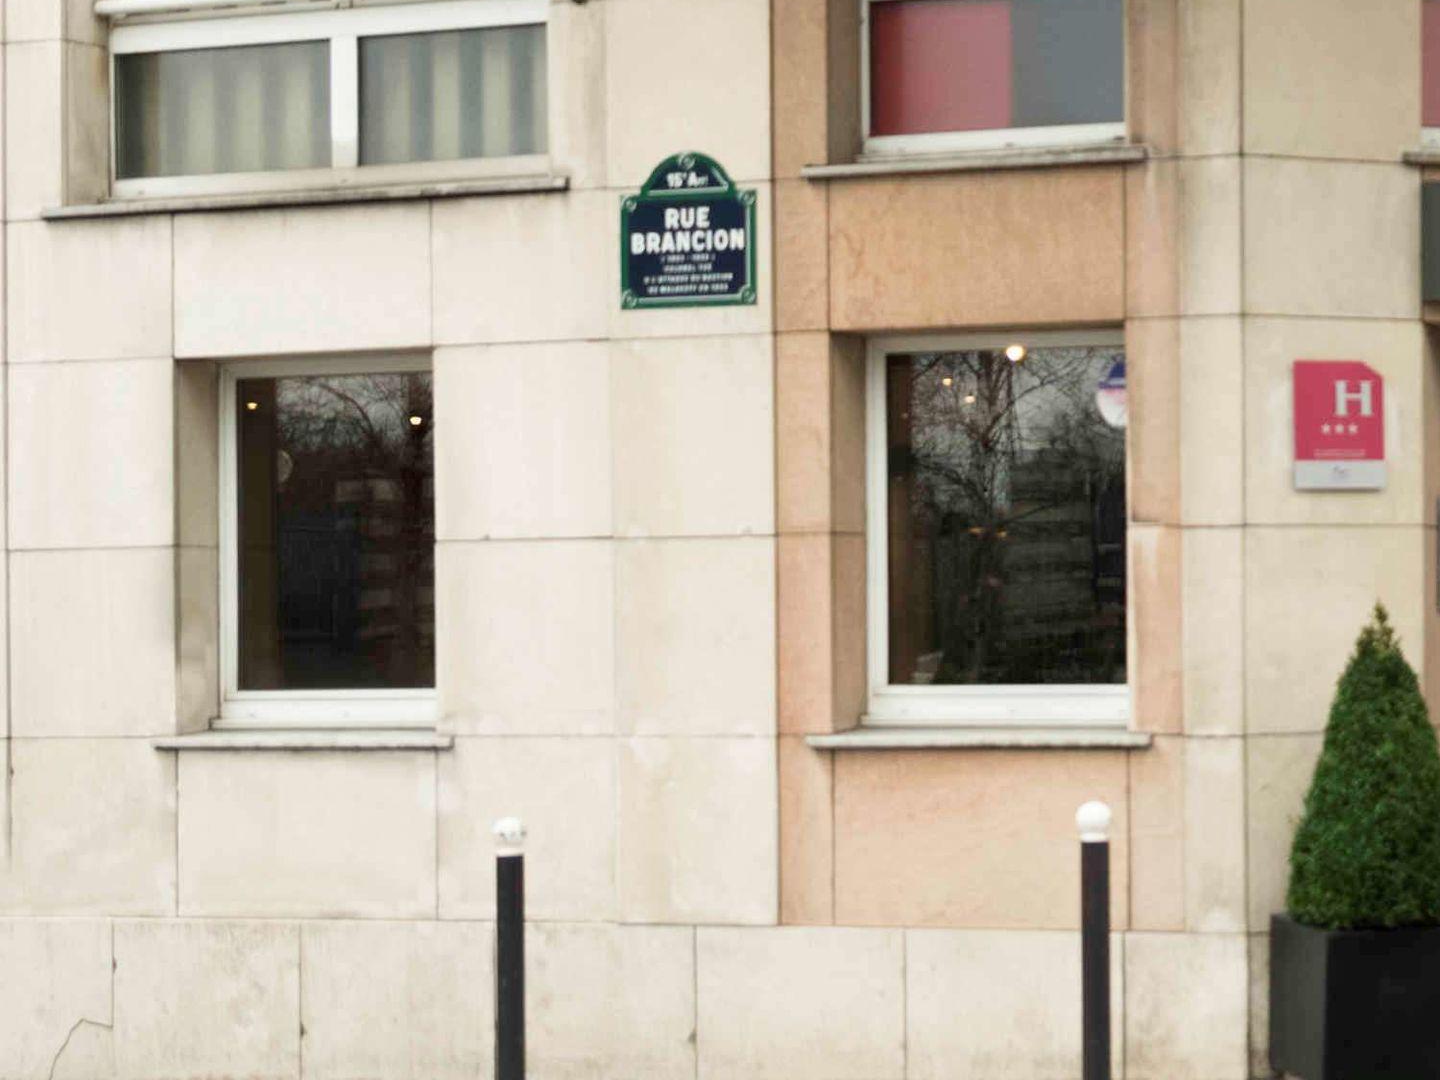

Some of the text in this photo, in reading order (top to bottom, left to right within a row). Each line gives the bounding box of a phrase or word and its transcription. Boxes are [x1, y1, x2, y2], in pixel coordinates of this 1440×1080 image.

[664, 206, 710, 229] RUE
[631, 228, 744, 254] BRANCION
[1335, 380, 1373, 416] H
